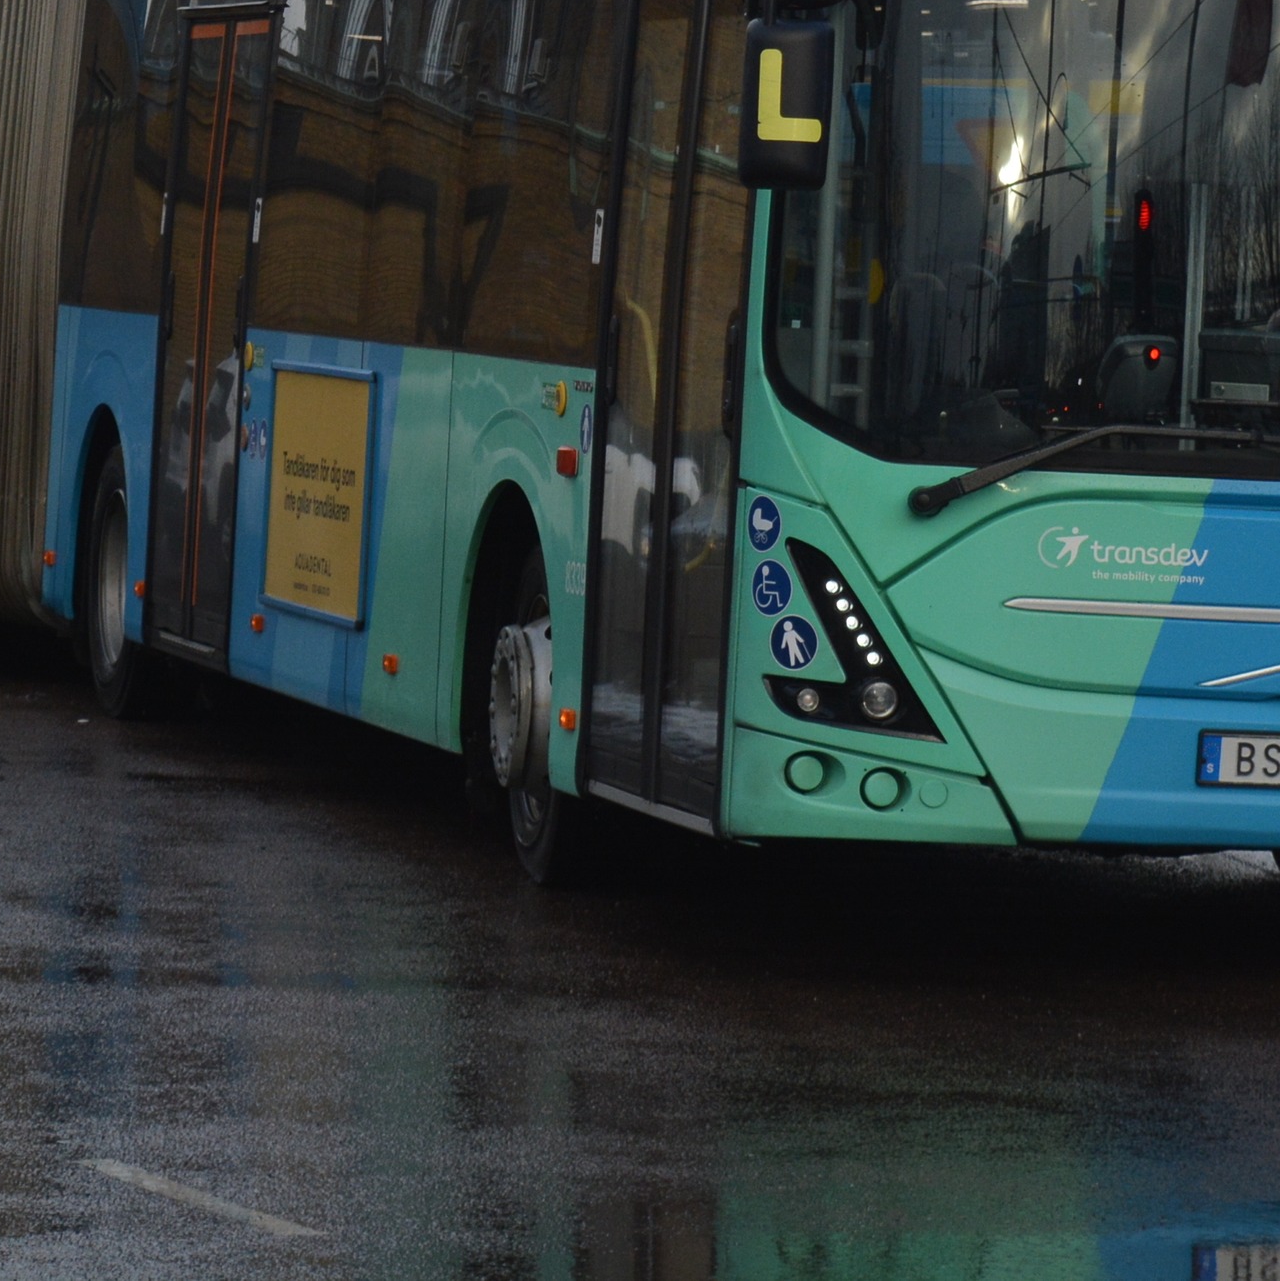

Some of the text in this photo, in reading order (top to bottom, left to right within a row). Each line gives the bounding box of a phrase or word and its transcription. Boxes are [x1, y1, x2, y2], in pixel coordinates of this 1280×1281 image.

[1090, 540, 1209, 567] transdev
[565, 560, 586, 596] 8339
[1092, 570, 1205, 586] the mobility company
[1206, 763, 1214, 774] S
